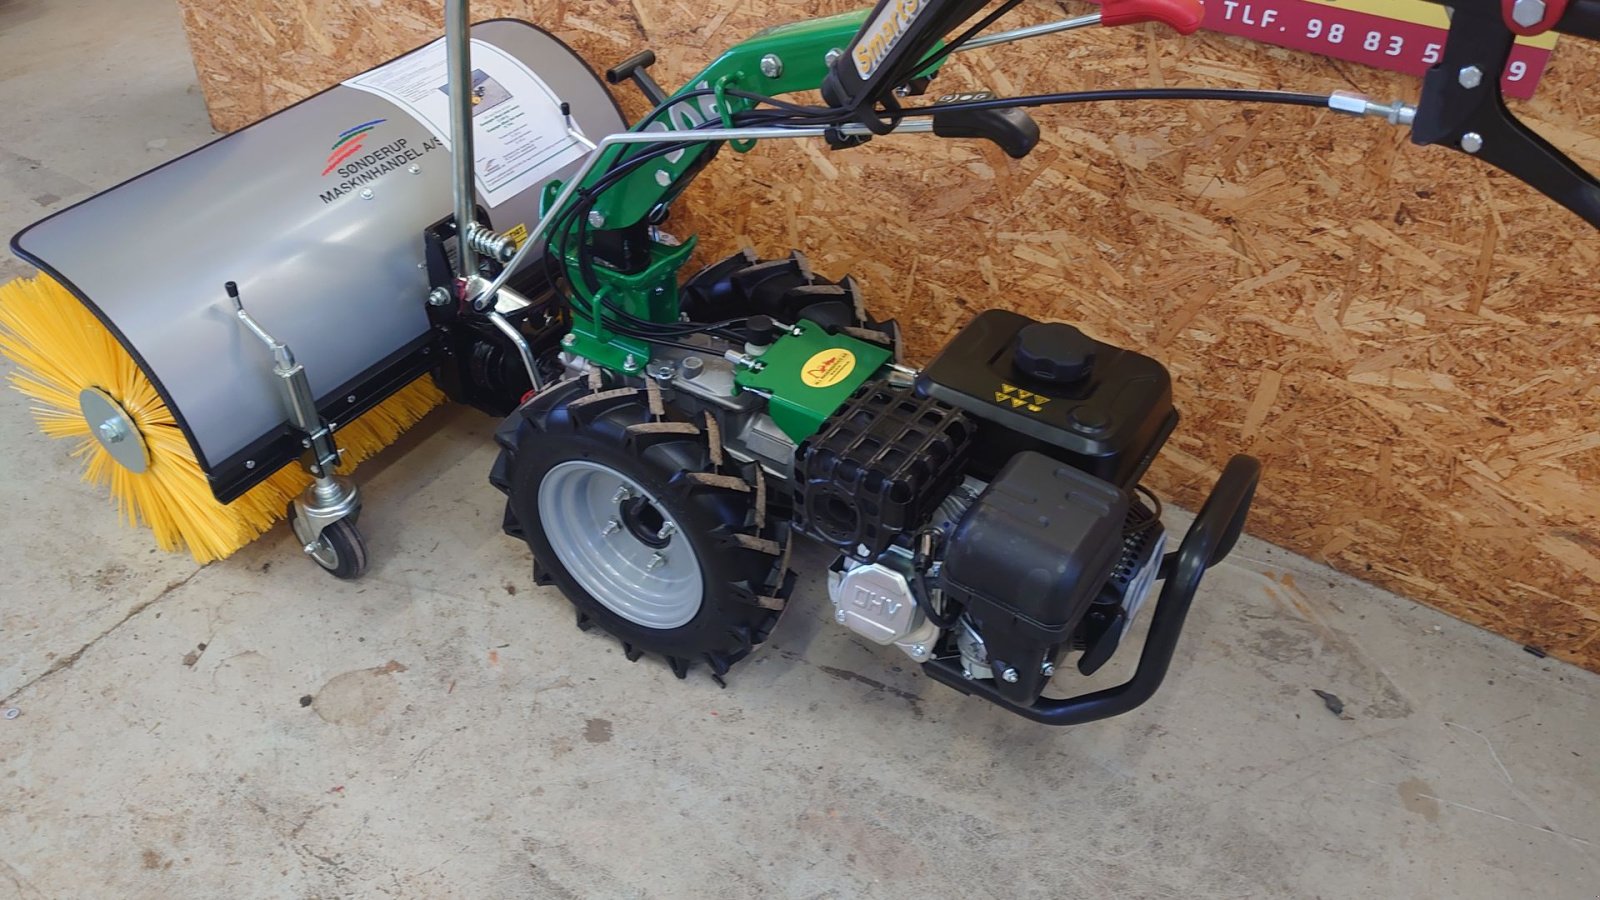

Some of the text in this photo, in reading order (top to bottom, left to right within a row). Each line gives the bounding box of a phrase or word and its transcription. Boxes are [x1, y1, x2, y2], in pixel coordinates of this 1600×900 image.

[1223, 0, 1527, 82] TLF. 98 83 5 9
[319, 148, 423, 204] MASKINHANDEL
[337, 138, 407, 178] SØNDERUP
